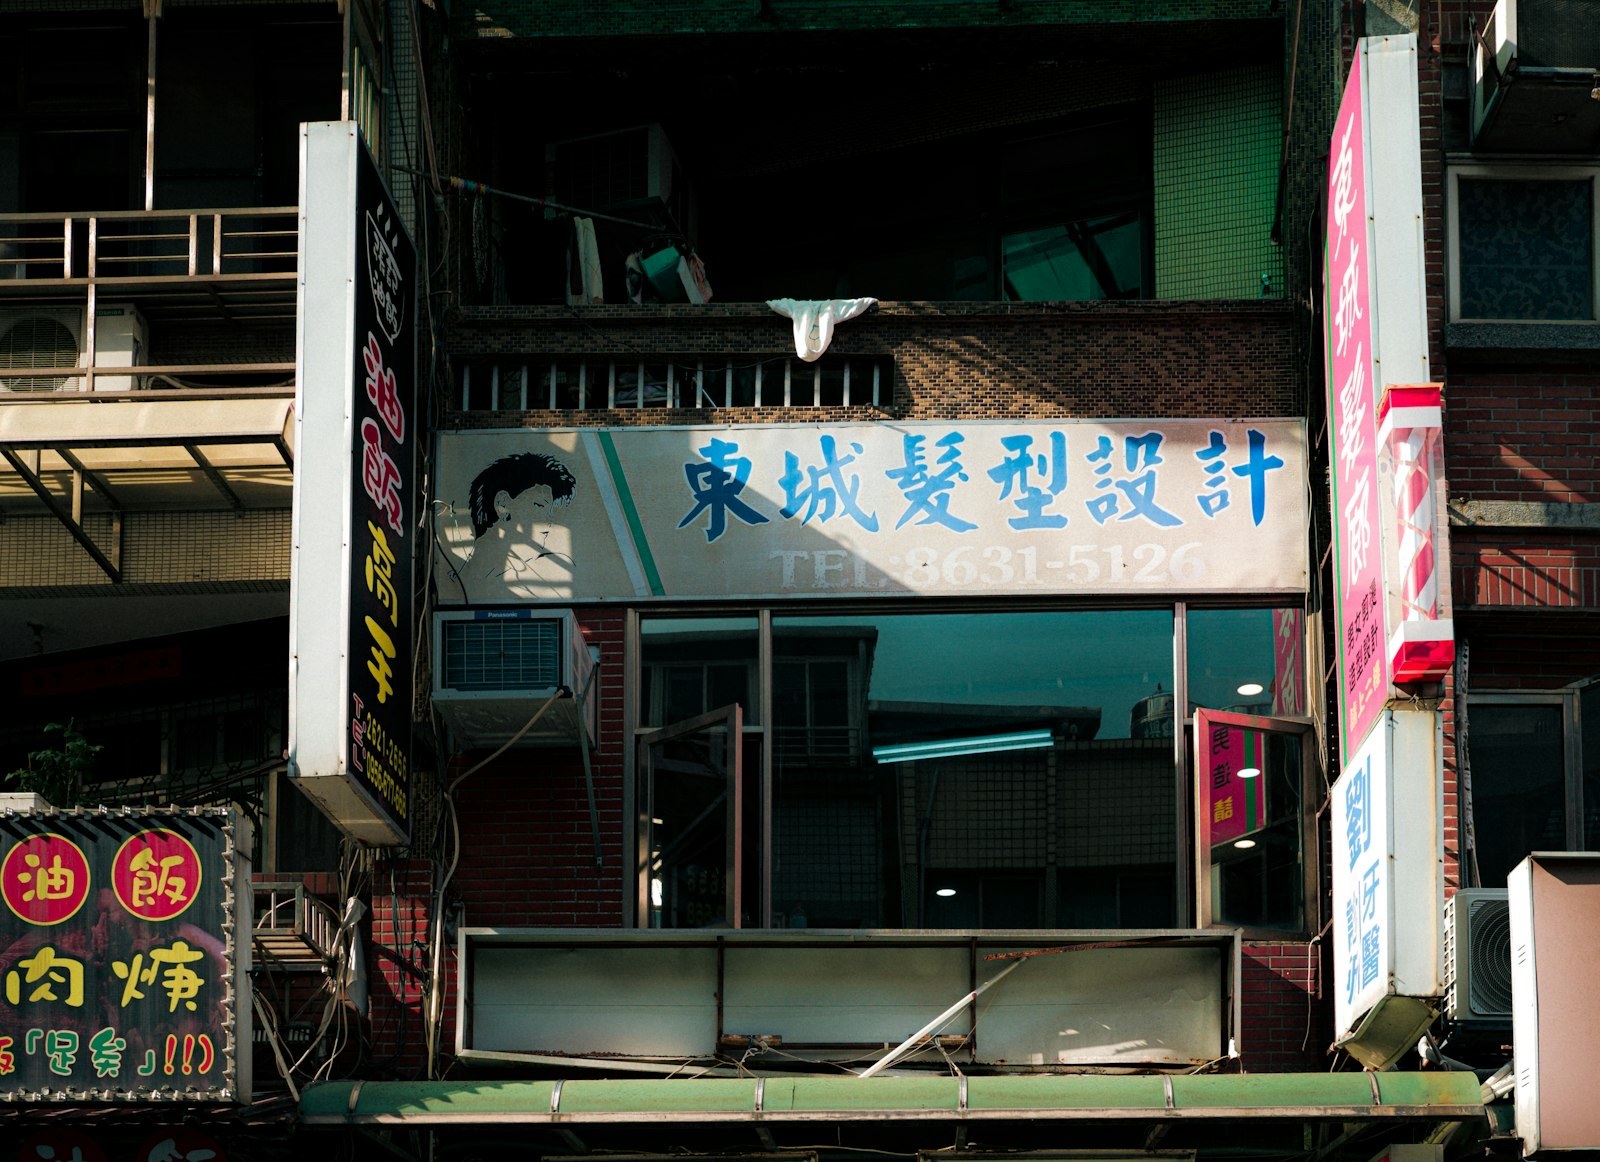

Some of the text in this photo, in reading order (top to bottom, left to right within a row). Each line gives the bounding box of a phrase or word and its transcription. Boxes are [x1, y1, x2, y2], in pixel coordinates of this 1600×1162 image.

[677, 429, 1285, 543] 東城髮型設計
[17, 846, 188, 908] 油飯
